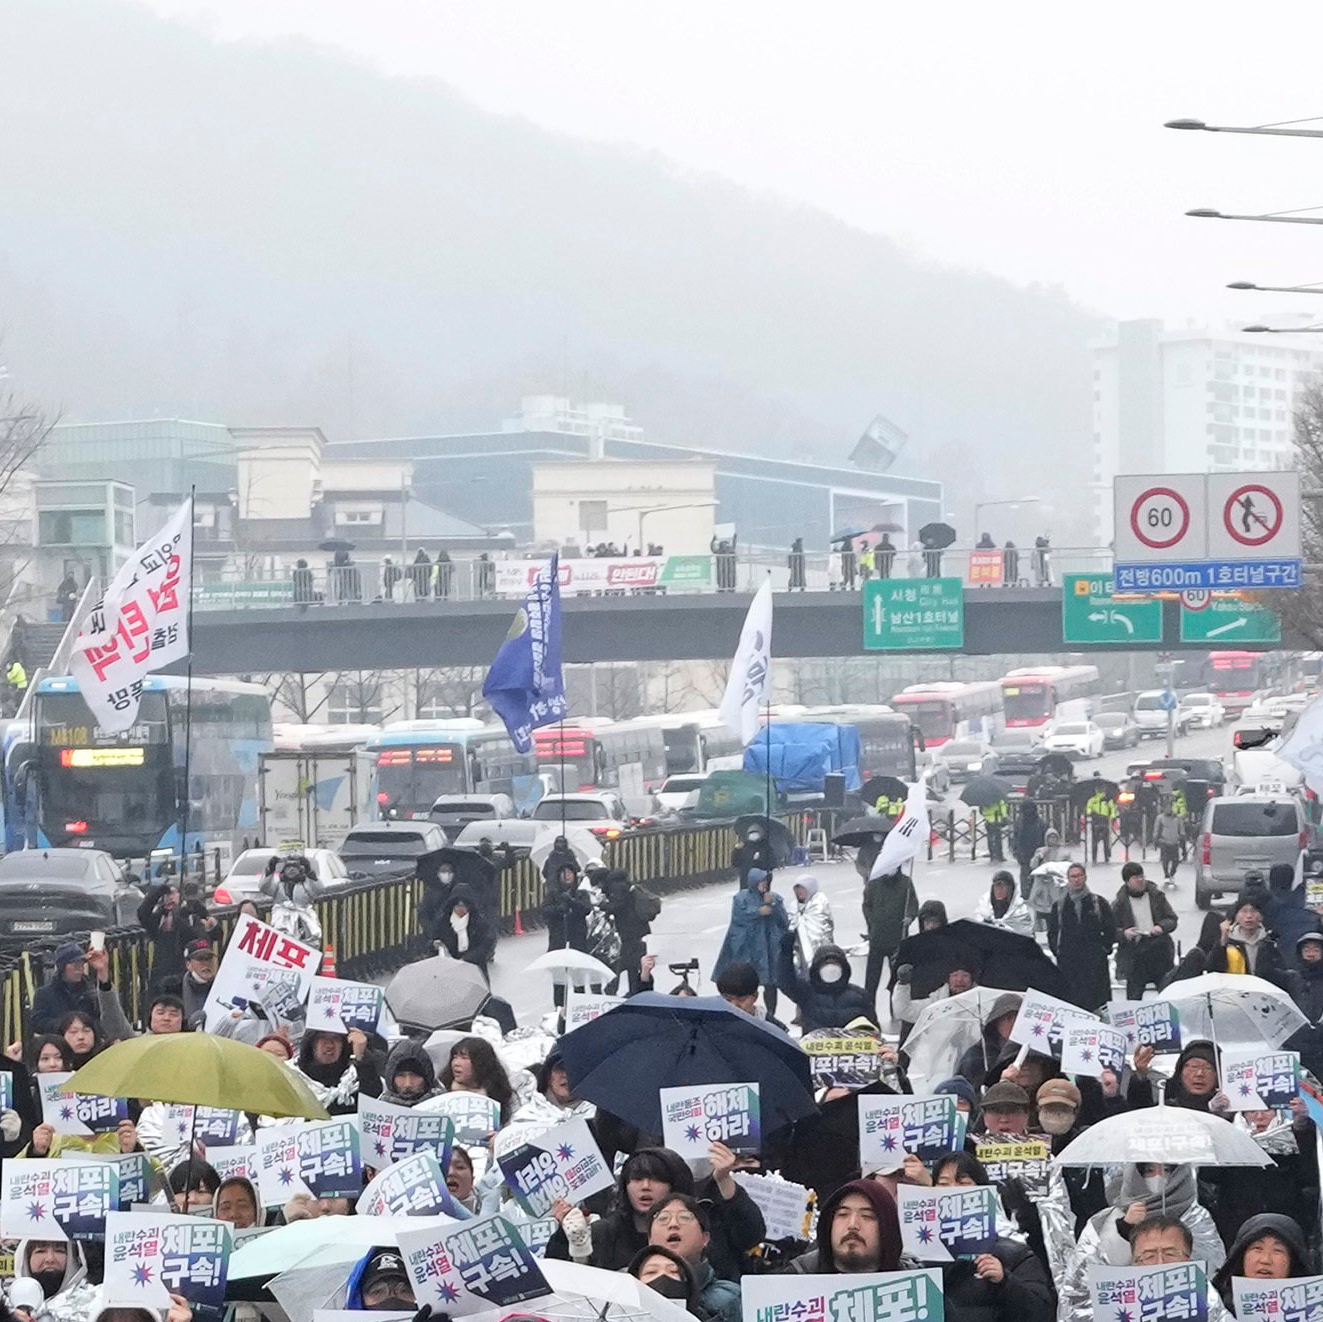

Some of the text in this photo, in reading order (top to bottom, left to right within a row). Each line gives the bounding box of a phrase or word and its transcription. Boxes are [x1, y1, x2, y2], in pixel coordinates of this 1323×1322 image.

[1147, 507, 1173, 528] 60
[1118, 566, 1201, 589] 전방600m
[1207, 562, 1298, 584] 1호터널구간
[891, 588, 917, 602] 시청
[238, 921, 310, 969] 체포
[1136, 1002, 1170, 1024] 해체
[805, 1040, 873, 1051] 내란수괴 윤석열
[1255, 1055, 1294, 1075] 체포!
[901, 1097, 952, 1128] 체포!
[298, 1123, 354, 1154] 체포!
[1014, 1144, 1042, 1156] 윤석열
[52, 1165, 113, 1195] 체포!
[301, 1150, 356, 1185] 구속!
[53, 1190, 113, 1222] 구속!
[938, 1187, 990, 1218] 체포!
[161, 1222, 229, 1255] 체포!
[162, 1254, 224, 1288] 구속!
[1137, 1266, 1197, 1303] 체포!
